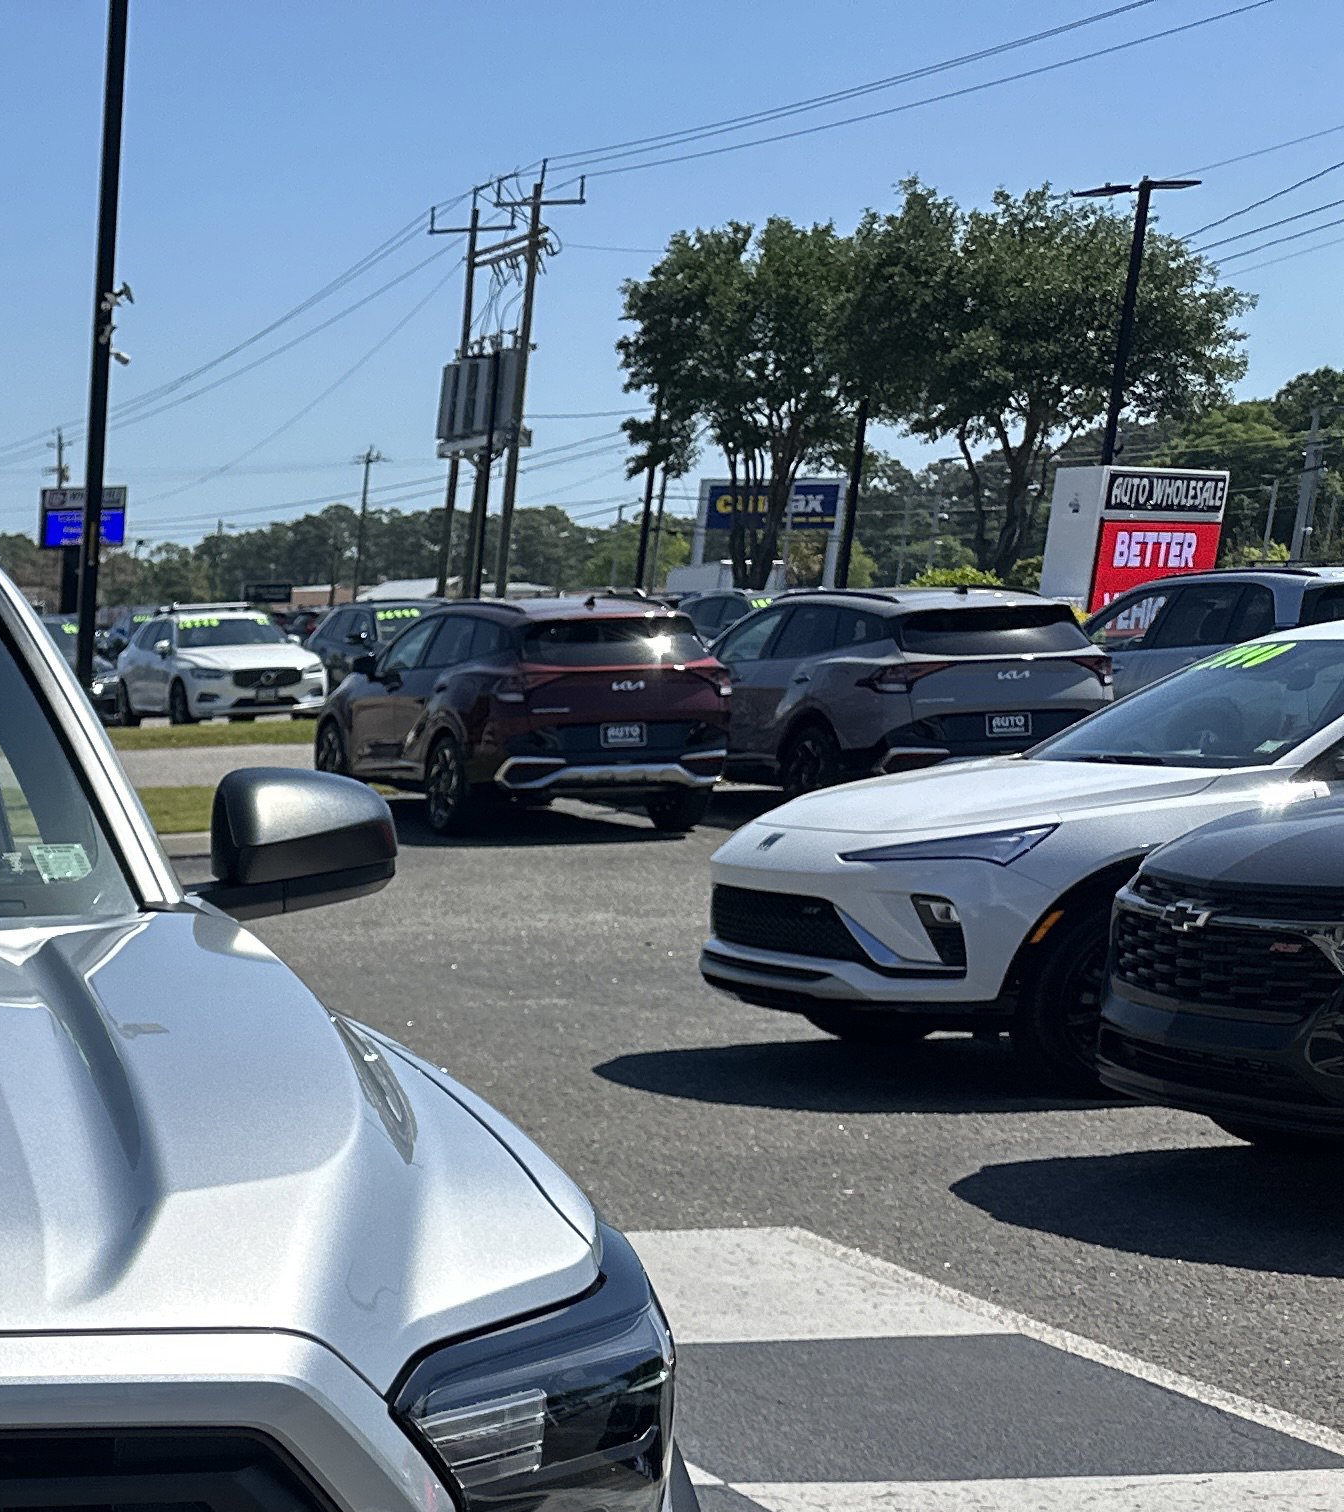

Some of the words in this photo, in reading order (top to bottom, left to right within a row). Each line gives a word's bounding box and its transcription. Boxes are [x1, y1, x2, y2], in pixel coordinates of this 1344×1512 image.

[1111, 476, 1150, 507] AUTO
[1151, 478, 1225, 508] WHOLESALE
[1113, 531, 1198, 568] BETTER
[606, 725, 641, 737] AUTO
[991, 715, 1025, 727] AUTO
